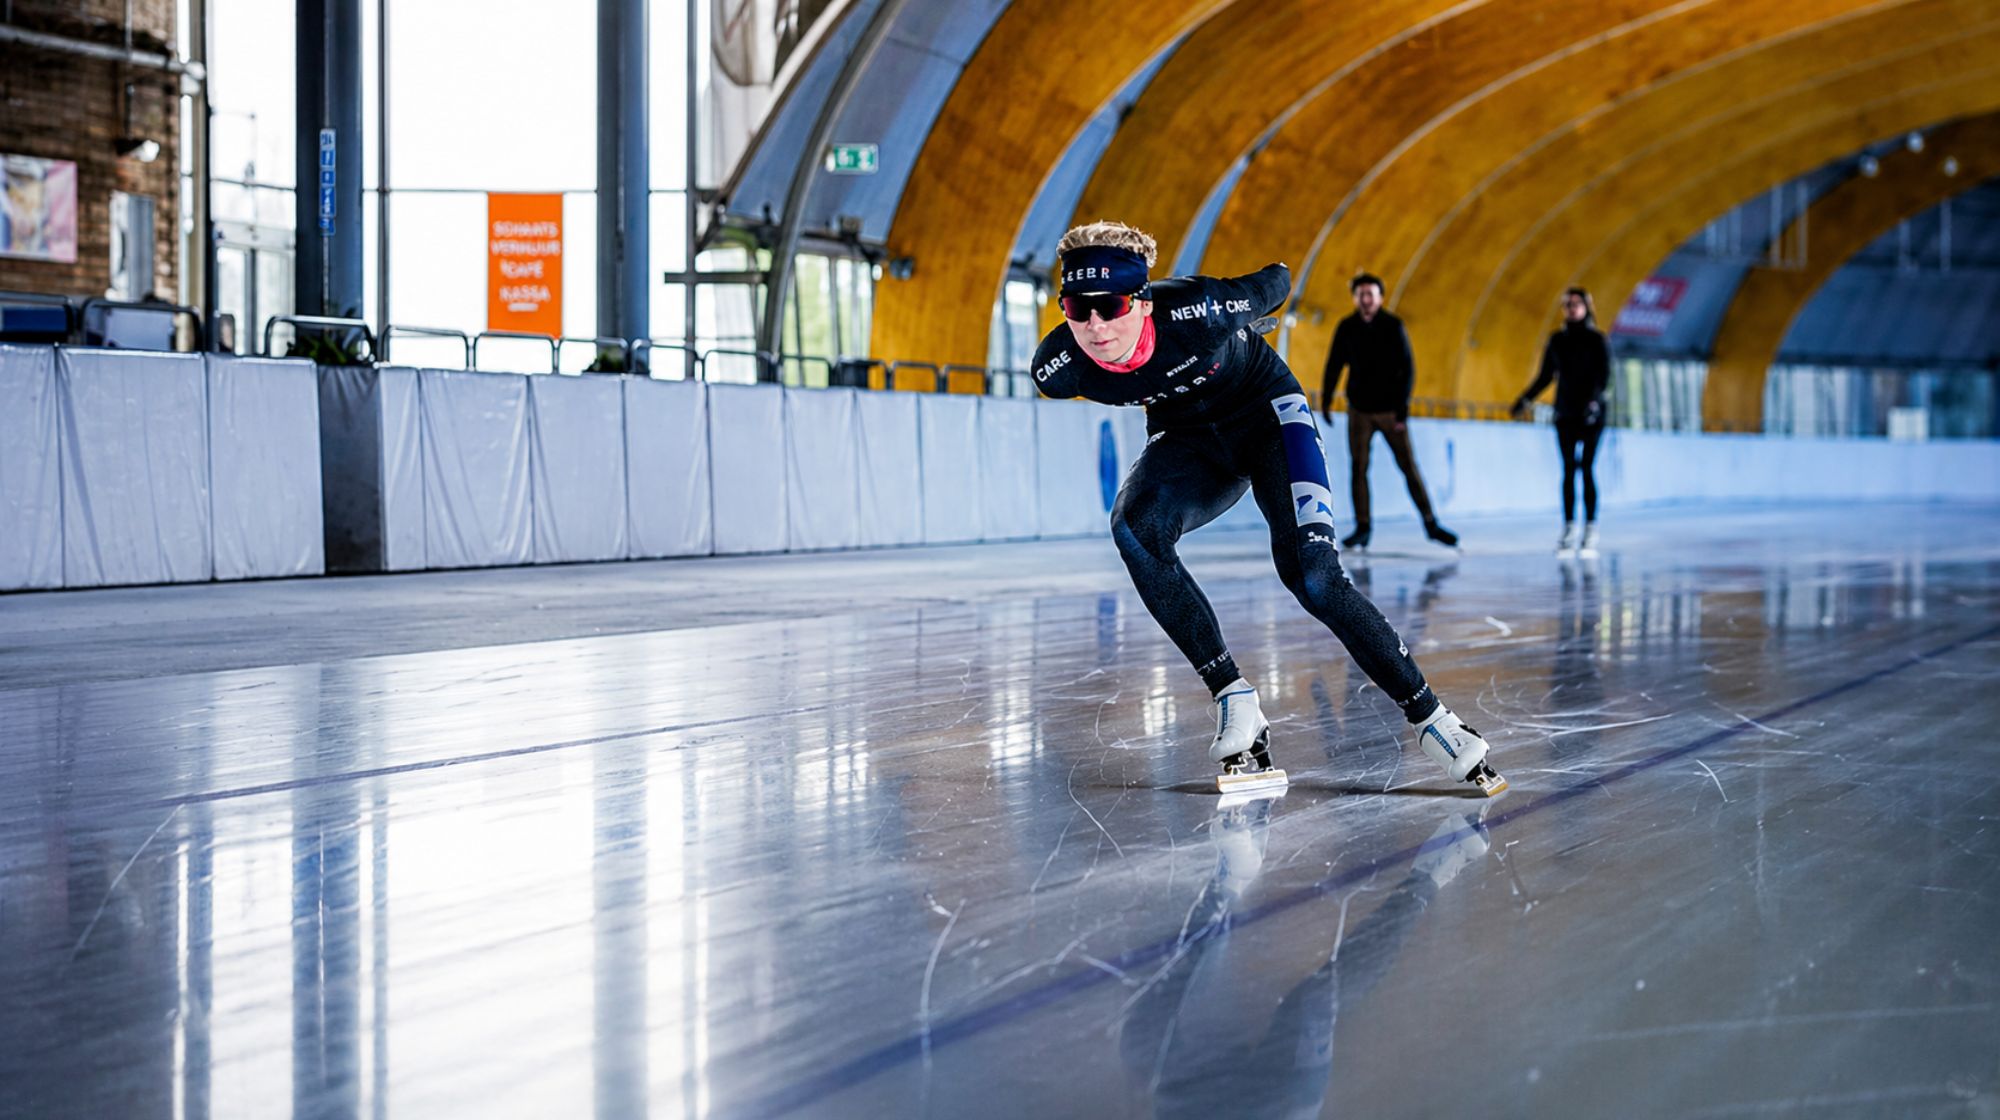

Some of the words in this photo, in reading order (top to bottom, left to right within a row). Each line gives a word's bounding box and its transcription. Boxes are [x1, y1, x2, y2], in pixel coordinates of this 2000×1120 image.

[1171, 302, 1208, 321] NEW
[1226, 299, 1252, 314] CARE
[1036, 350, 1072, 382] CARE
